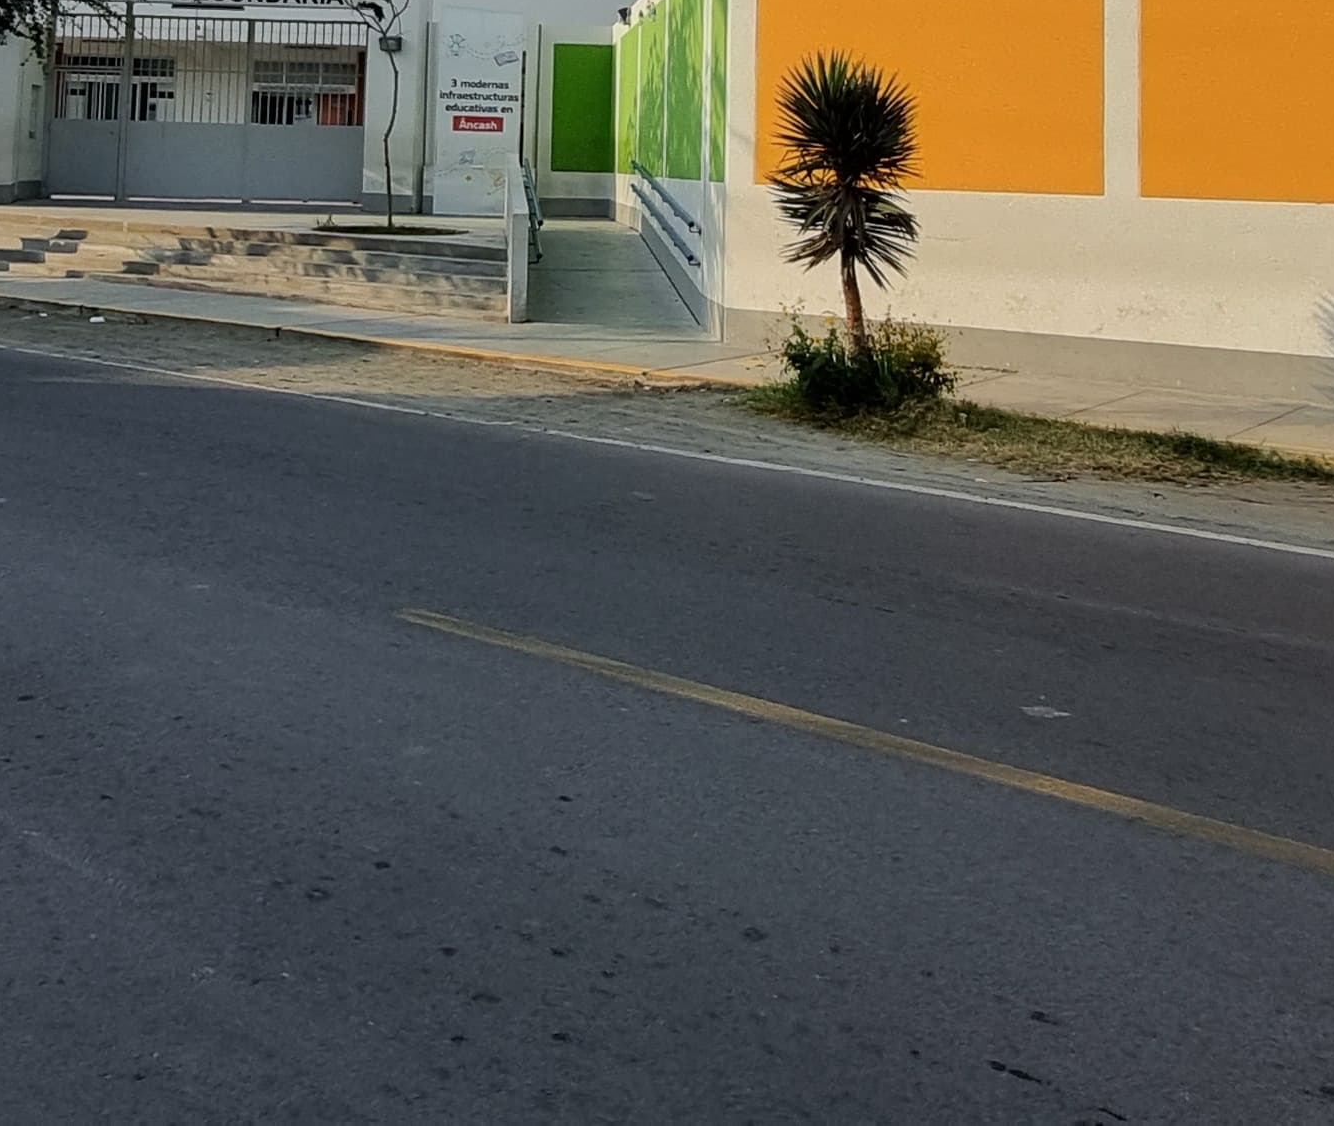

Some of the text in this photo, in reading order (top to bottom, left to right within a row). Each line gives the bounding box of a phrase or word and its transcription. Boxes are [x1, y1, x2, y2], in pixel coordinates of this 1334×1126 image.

[450, 78, 510, 90] 3 modernas
[439, 90, 519, 102] infraestructuras
[445, 103, 514, 114] educativas en
